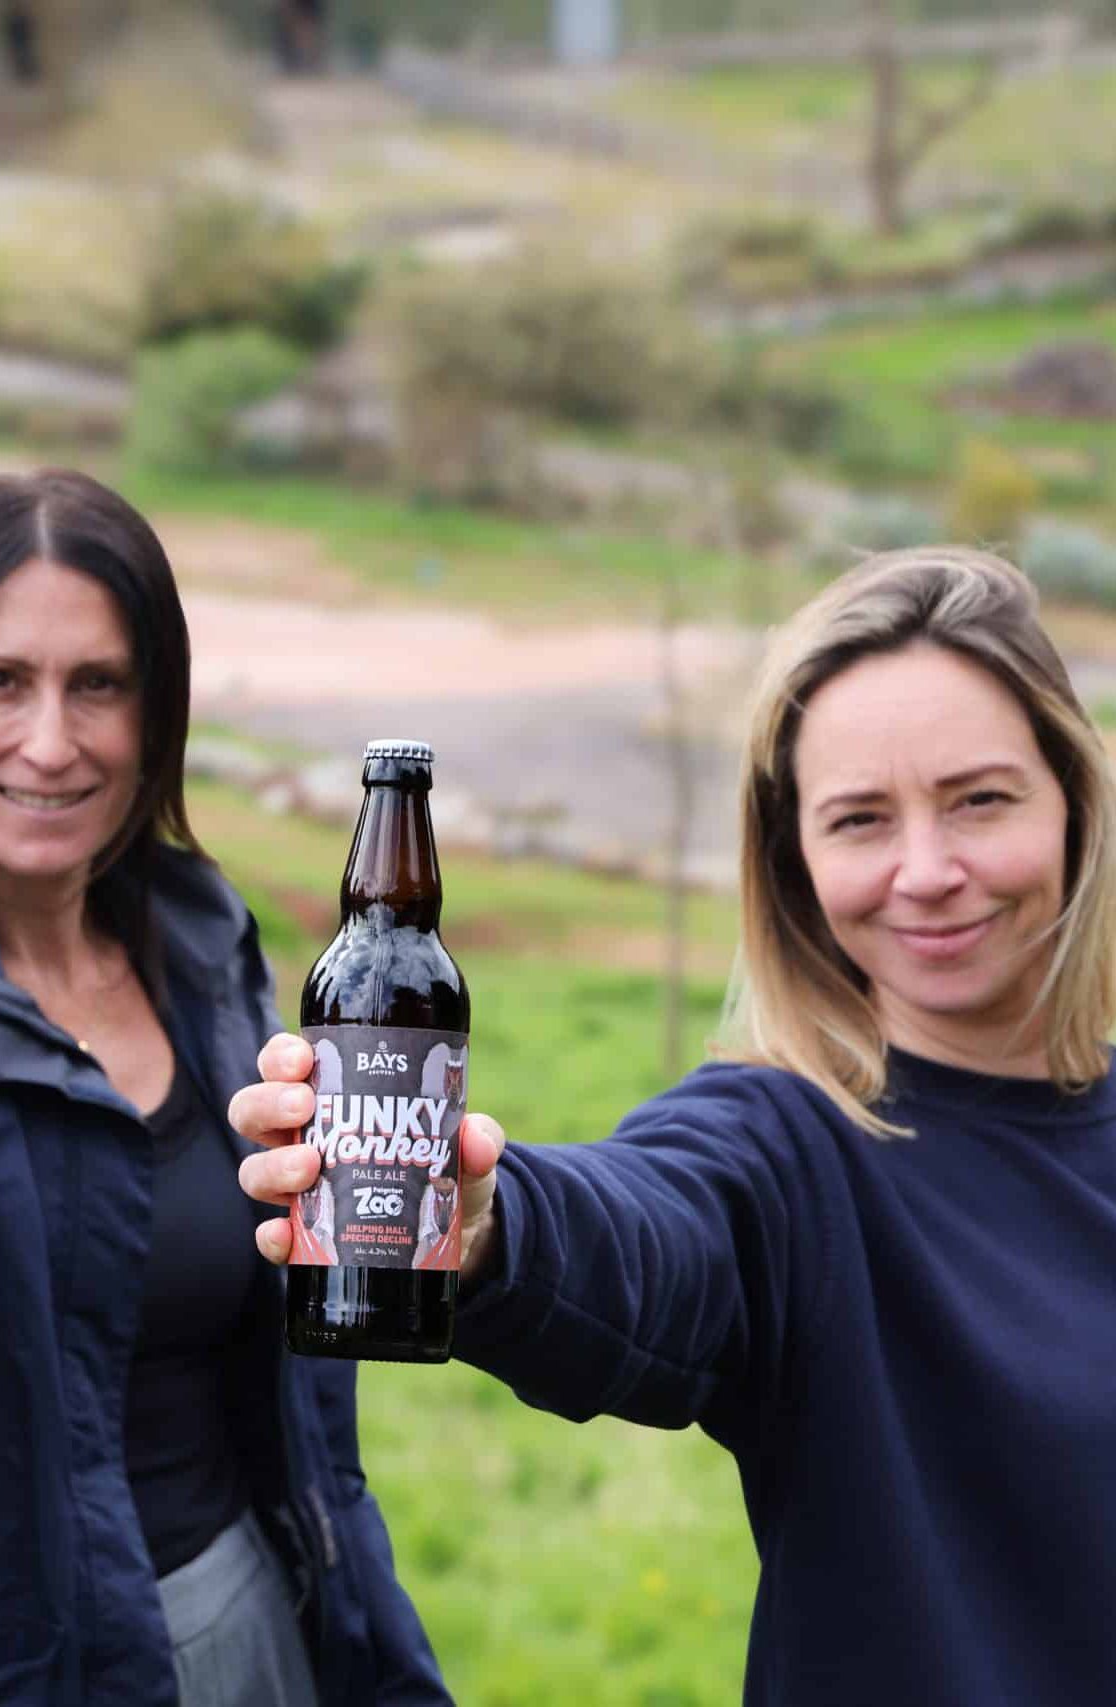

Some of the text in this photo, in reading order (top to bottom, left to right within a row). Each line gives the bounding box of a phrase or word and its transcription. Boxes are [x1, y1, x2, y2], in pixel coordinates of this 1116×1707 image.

[357, 1052, 408, 1072] BAYS
[315, 1094, 448, 1137] FUNKY
[306, 1126, 451, 1179] Monkey
[352, 1168, 407, 1181] PALE ALE
[340, 1233, 375, 1242] SPECIES
[346, 1224, 408, 1235] HELPING HALT
